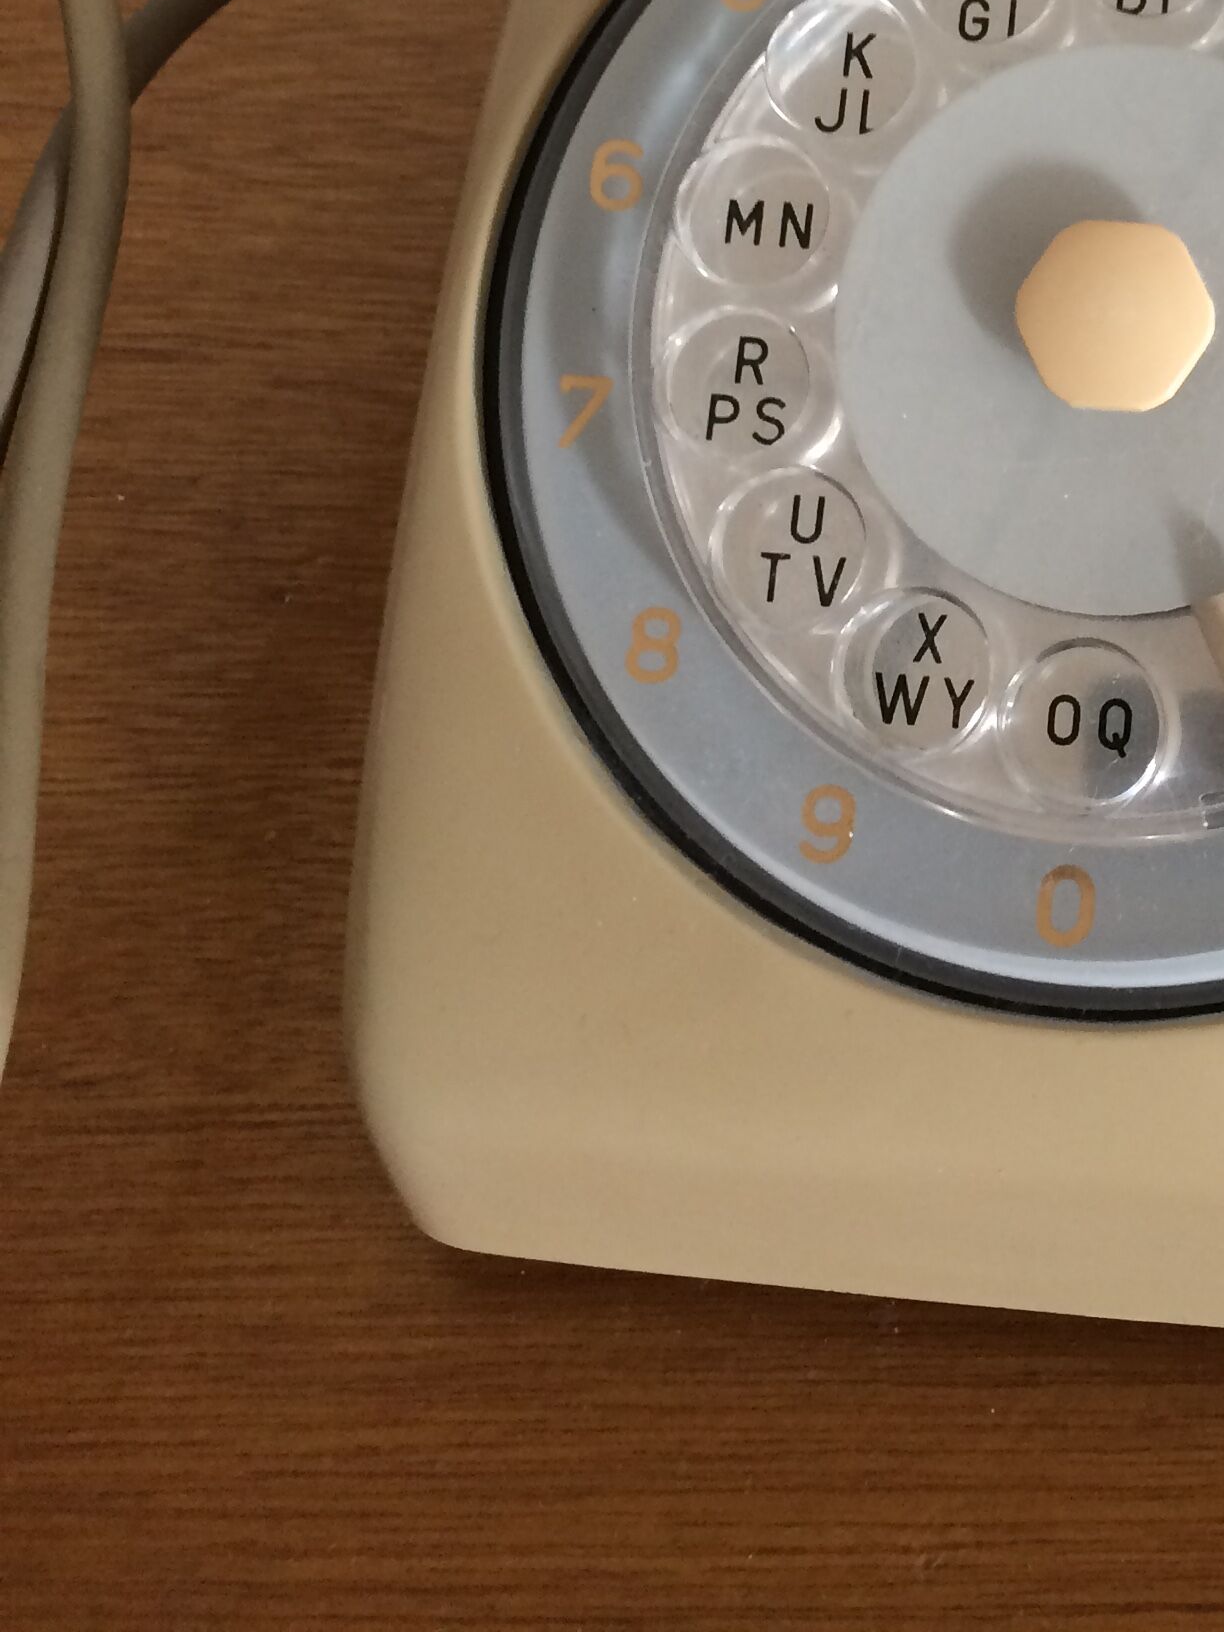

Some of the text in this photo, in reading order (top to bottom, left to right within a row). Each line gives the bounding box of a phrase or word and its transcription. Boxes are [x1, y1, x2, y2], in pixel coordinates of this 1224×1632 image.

[842, 31, 877, 80] K
[591, 140, 643, 210] 6
[733, 335, 770, 386] R
[559, 376, 611, 448] 7
[789, 494, 826, 545] U
[626, 608, 681, 683] 8
[911, 612, 949, 665] X
[802, 786, 855, 862] 9
[1037, 865, 1096, 947] 0
